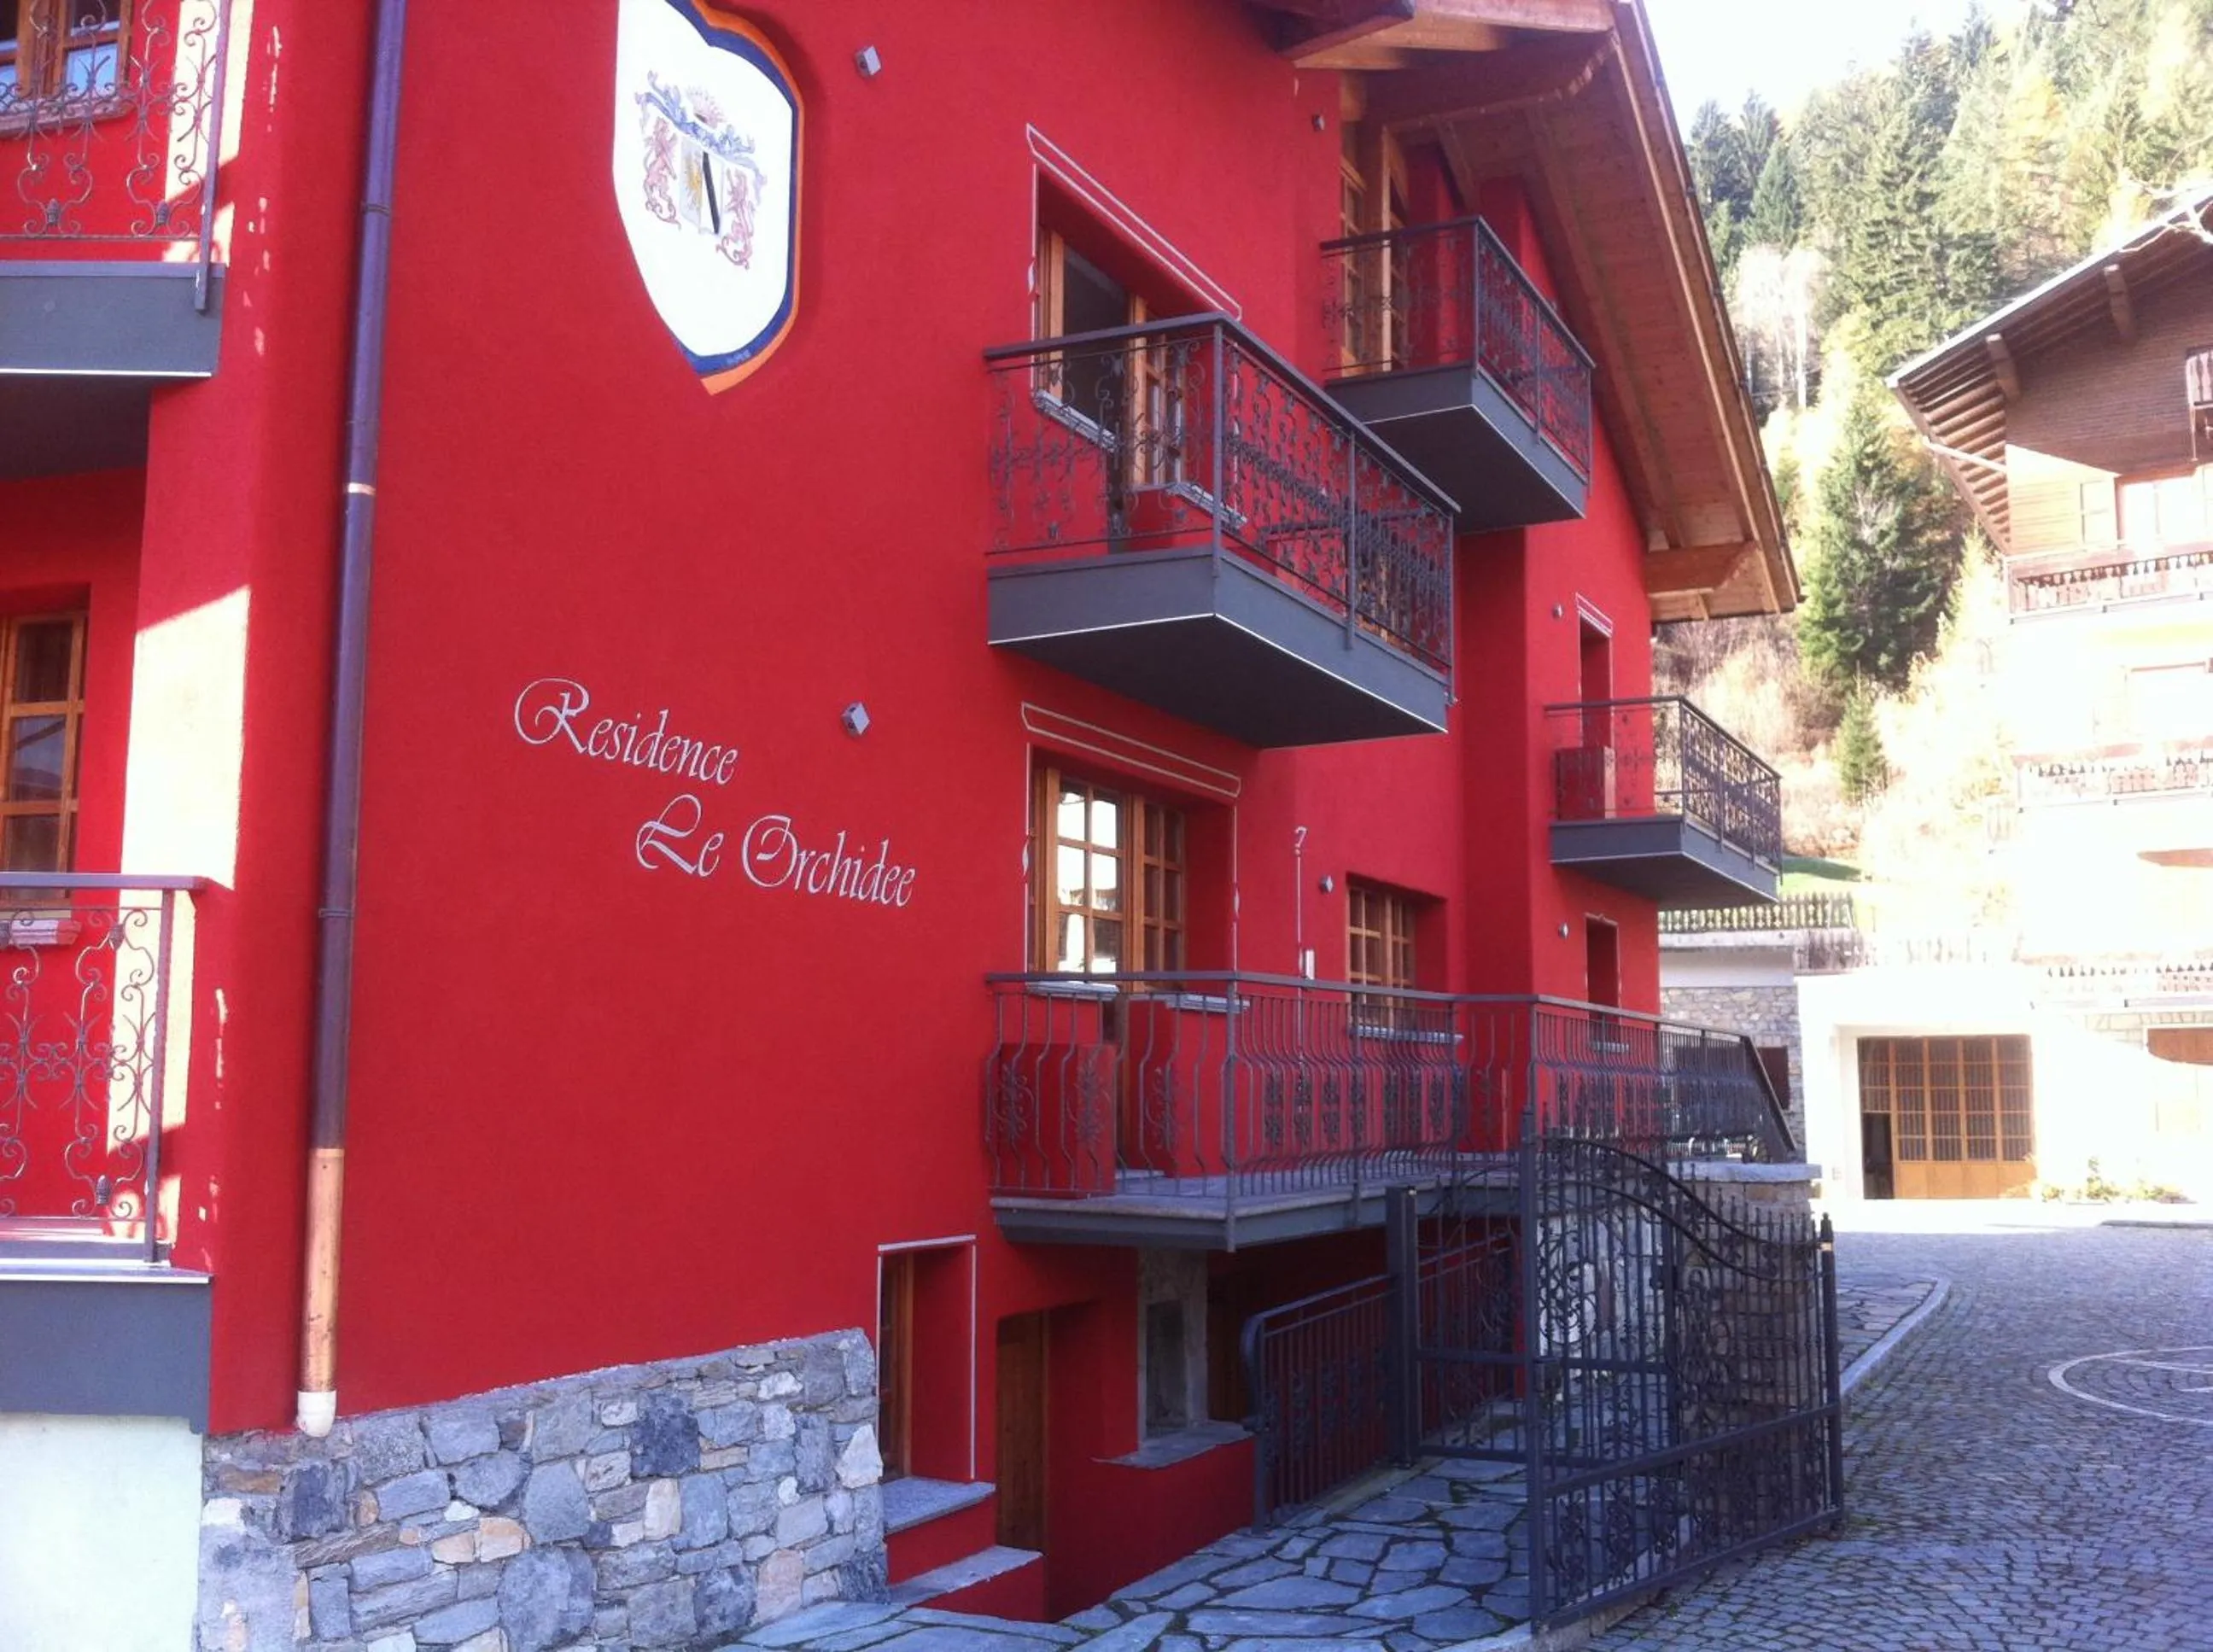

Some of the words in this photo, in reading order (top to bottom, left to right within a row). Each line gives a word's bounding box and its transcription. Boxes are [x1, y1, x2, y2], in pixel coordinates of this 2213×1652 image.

[514, 678, 739, 785] Residence
[635, 794, 724, 877] Le
[741, 814, 916, 908] Orchidee
